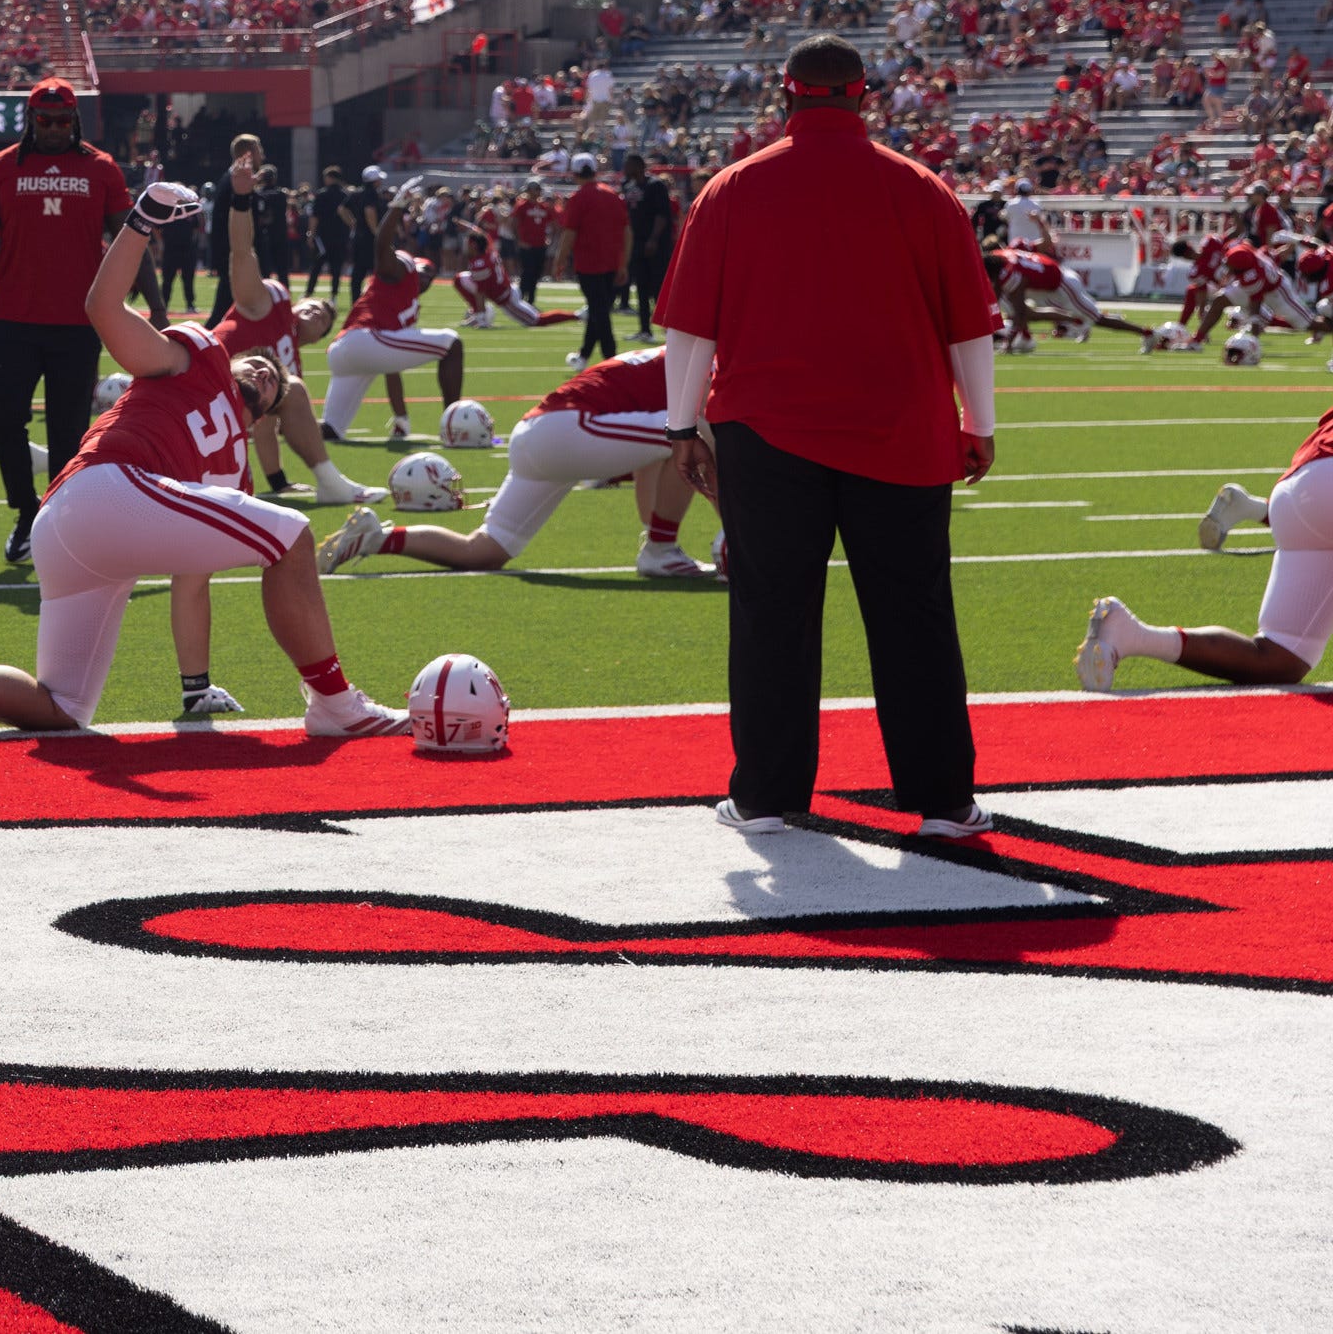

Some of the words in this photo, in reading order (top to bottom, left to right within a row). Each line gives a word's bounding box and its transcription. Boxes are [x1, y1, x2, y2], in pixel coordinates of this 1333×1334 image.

[17, 177, 89, 193] HUSKERS
[43, 197, 62, 215] N
[424, 721, 461, 742] 57
